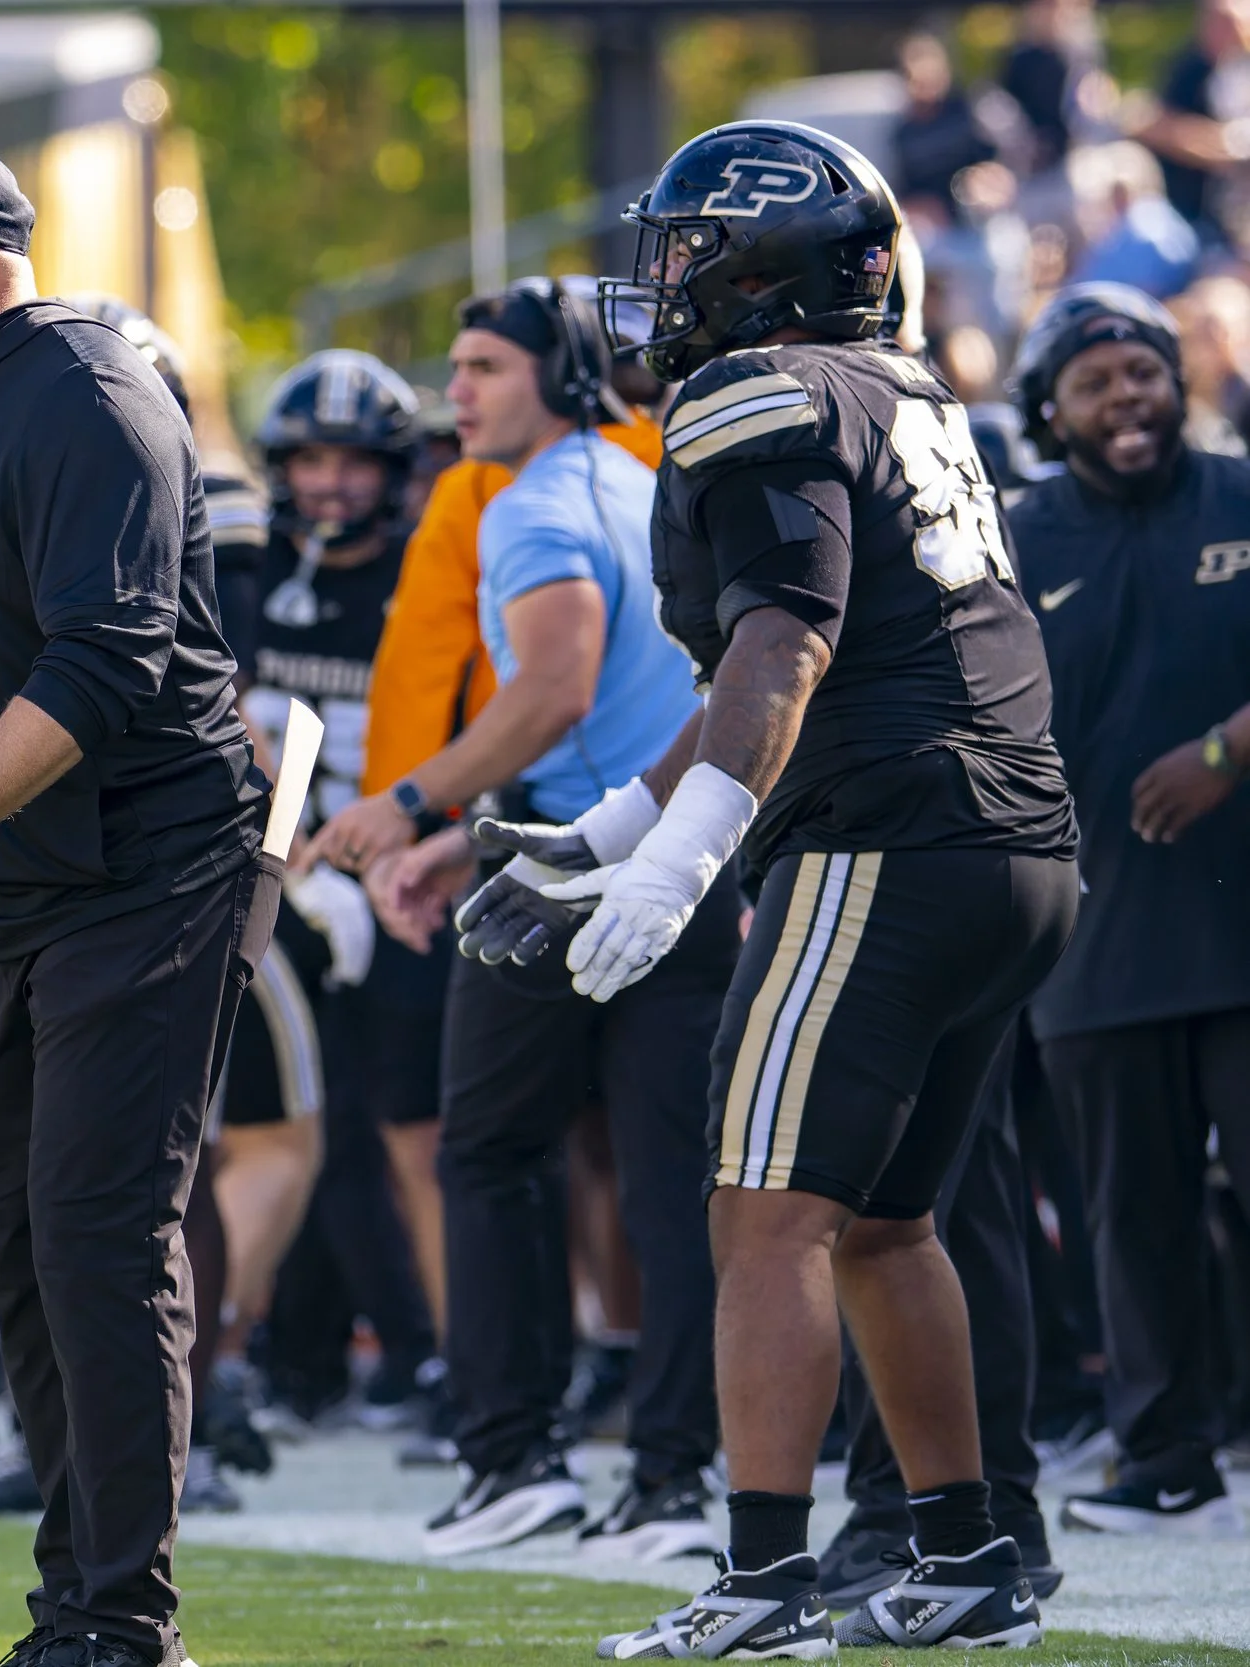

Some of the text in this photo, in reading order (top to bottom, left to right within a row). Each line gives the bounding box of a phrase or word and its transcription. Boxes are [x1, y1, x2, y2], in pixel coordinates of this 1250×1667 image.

[700, 158, 818, 217] P
[689, 1612, 734, 1651] ALPHA
[905, 1601, 945, 1636] ALPHA
